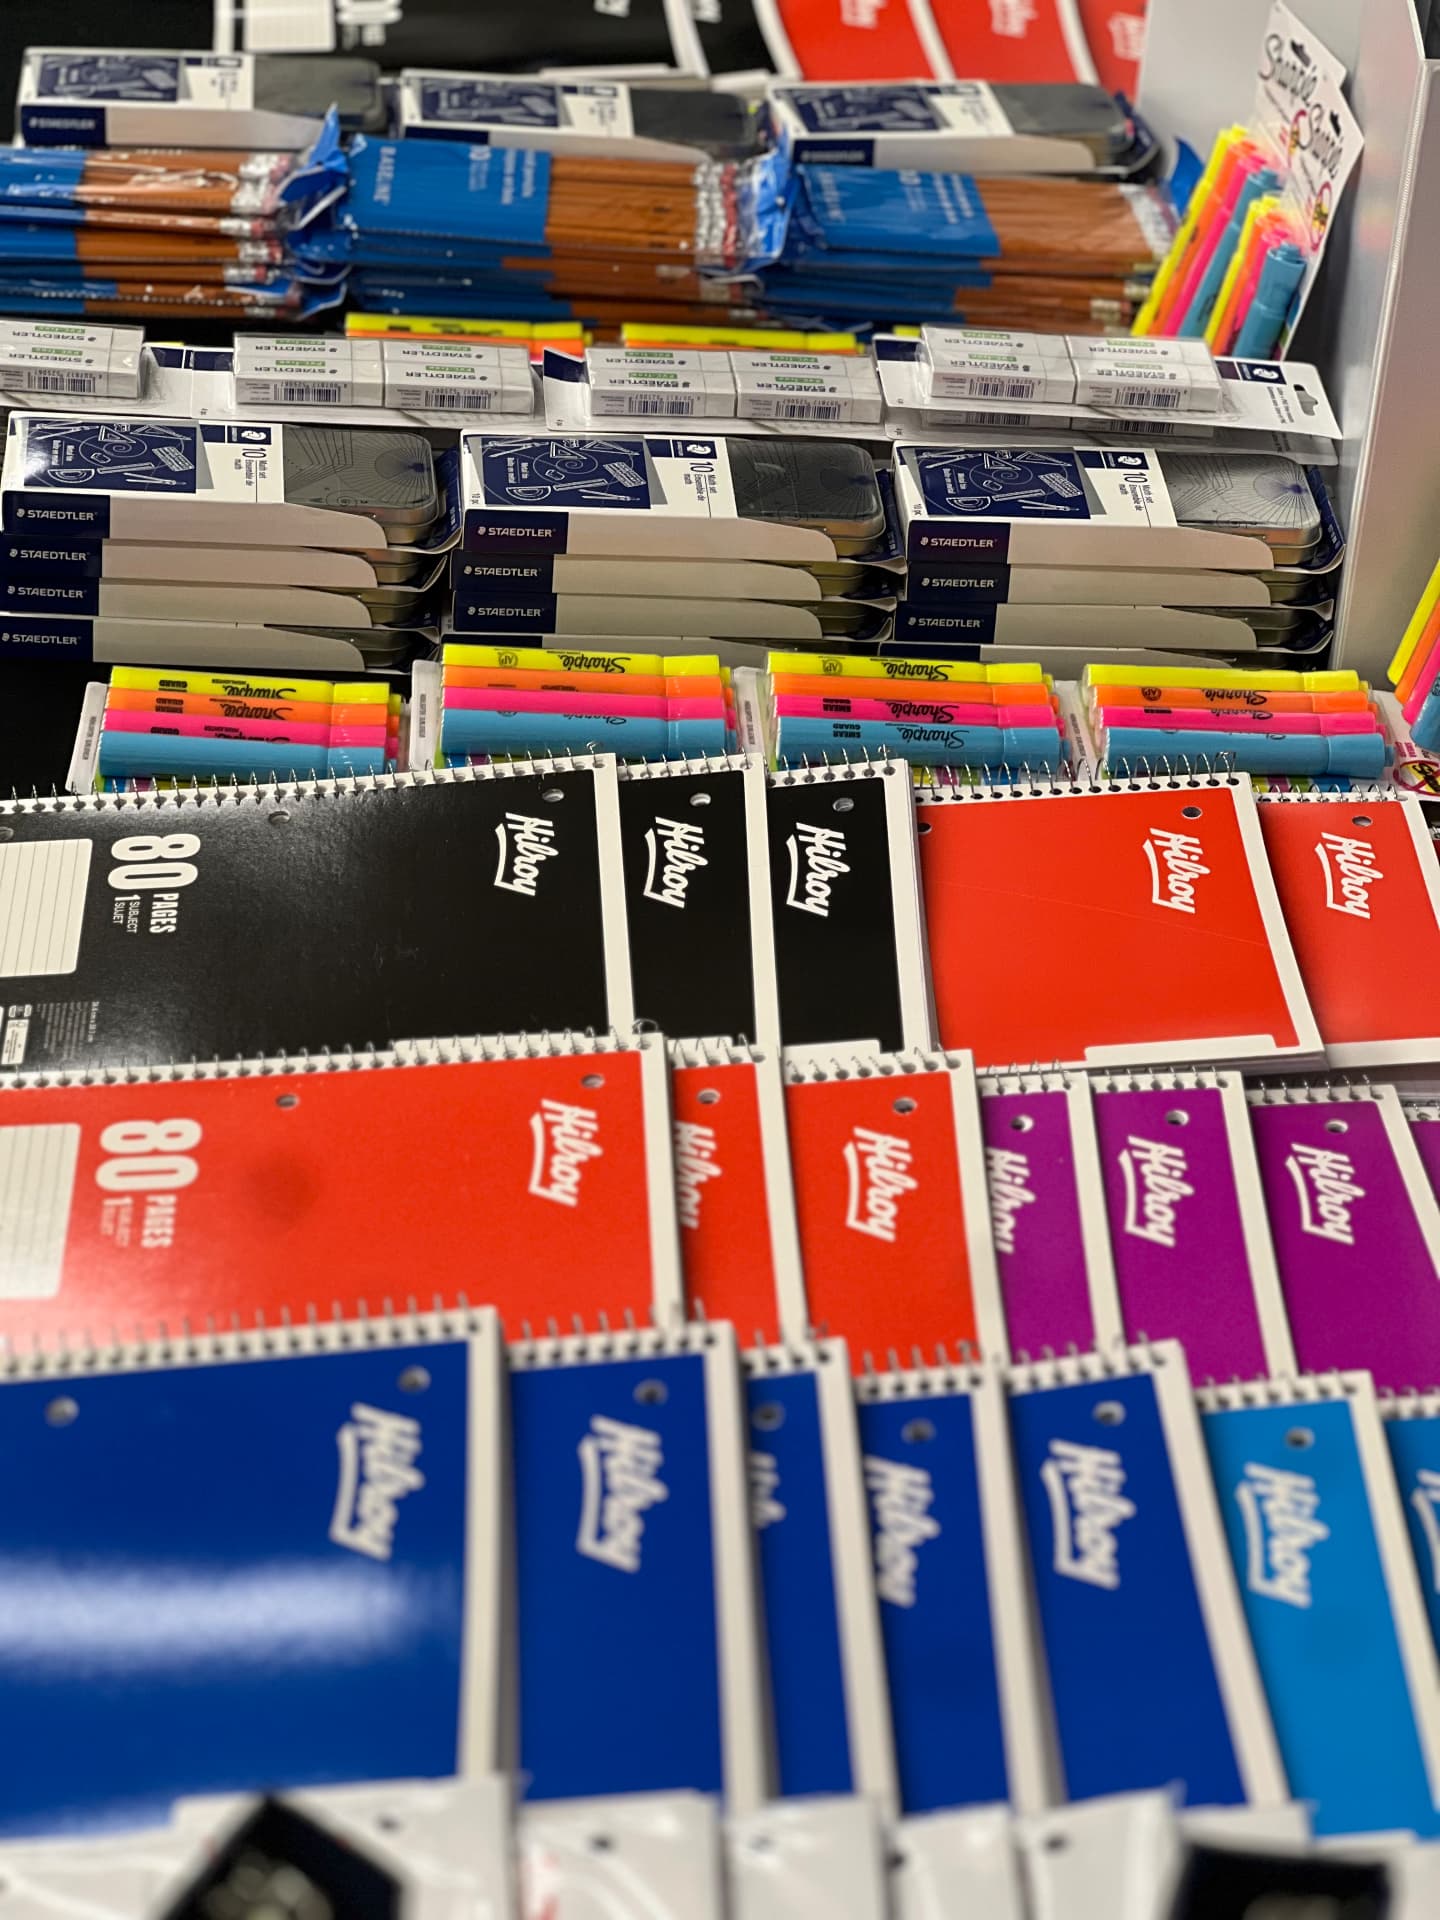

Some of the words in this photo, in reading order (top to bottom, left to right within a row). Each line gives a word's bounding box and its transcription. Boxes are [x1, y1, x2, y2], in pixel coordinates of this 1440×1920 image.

[12, 331, 85, 341] STAEDTLER
[944, 338, 1013, 347] STAEDTLER
[402, 350, 472, 359] STAEDTLER
[1088, 346, 1157, 355] STAEDTLER
[9, 353, 82, 363] STAEDTLER
[950, 360, 1019, 371] STAEDTLER
[406, 371, 476, 381] STAEDTLER
[1096, 369, 1166, 380] STAEDTLER
[609, 379, 678, 388] STAEDTLER
[756, 382, 826, 393] STAEDTLER
[242, 448, 267, 458] 10
[689, 462, 714, 473] 10
[1123, 472, 1148, 483] 10
[27, 509, 94, 520] STAEDTLER
[488, 527, 552, 537] STAEDTLER
[930, 538, 993, 547] STAEDTLER
[20, 550, 87, 561] STAEDTLER
[474, 567, 538, 576] STAEDTLER
[931, 578, 994, 587] STAEDTLER
[18, 587, 83, 598] STAEDTLER
[478, 607, 541, 616] STAEDTLER
[918, 618, 981, 628] STAEDTLER
[12, 634, 77, 645] STAEDTLER
[558, 654, 631, 673] Sharpie
[881, 662, 953, 680] Sharpie
[886, 702, 959, 723] Sharpie
[832, 731, 861, 739] SMEAR
[896, 727, 969, 750] Sharpie
[494, 811, 560, 896] Hilroy
[108, 833, 201, 890] 80
[642, 815, 709, 909] Hilroy
[785, 821, 853, 917] Hilroy
[1142, 826, 1211, 914] Hilroy
[1314, 830, 1376, 919] Hilroy
[113, 902, 125, 924] SUJET
[127, 901, 140, 933] SUBJECT
[149, 893, 179, 933] PAGES
[95, 1118, 203, 1192] 80
[527, 1098, 604, 1207] Hilroy
[843, 1126, 919, 1243] Hilroy
[1117, 1135, 1195, 1247] Hilroy
[1285, 1142, 1367, 1246] Hilroy
[141, 1194, 176, 1248] PAGES
[328, 1401, 426, 1562] Hilroy
[575, 1414, 670, 1575] Hilroy
[1040, 1438, 1136, 1591] Hilroy
[1235, 1462, 1330, 1608] Hilroy
